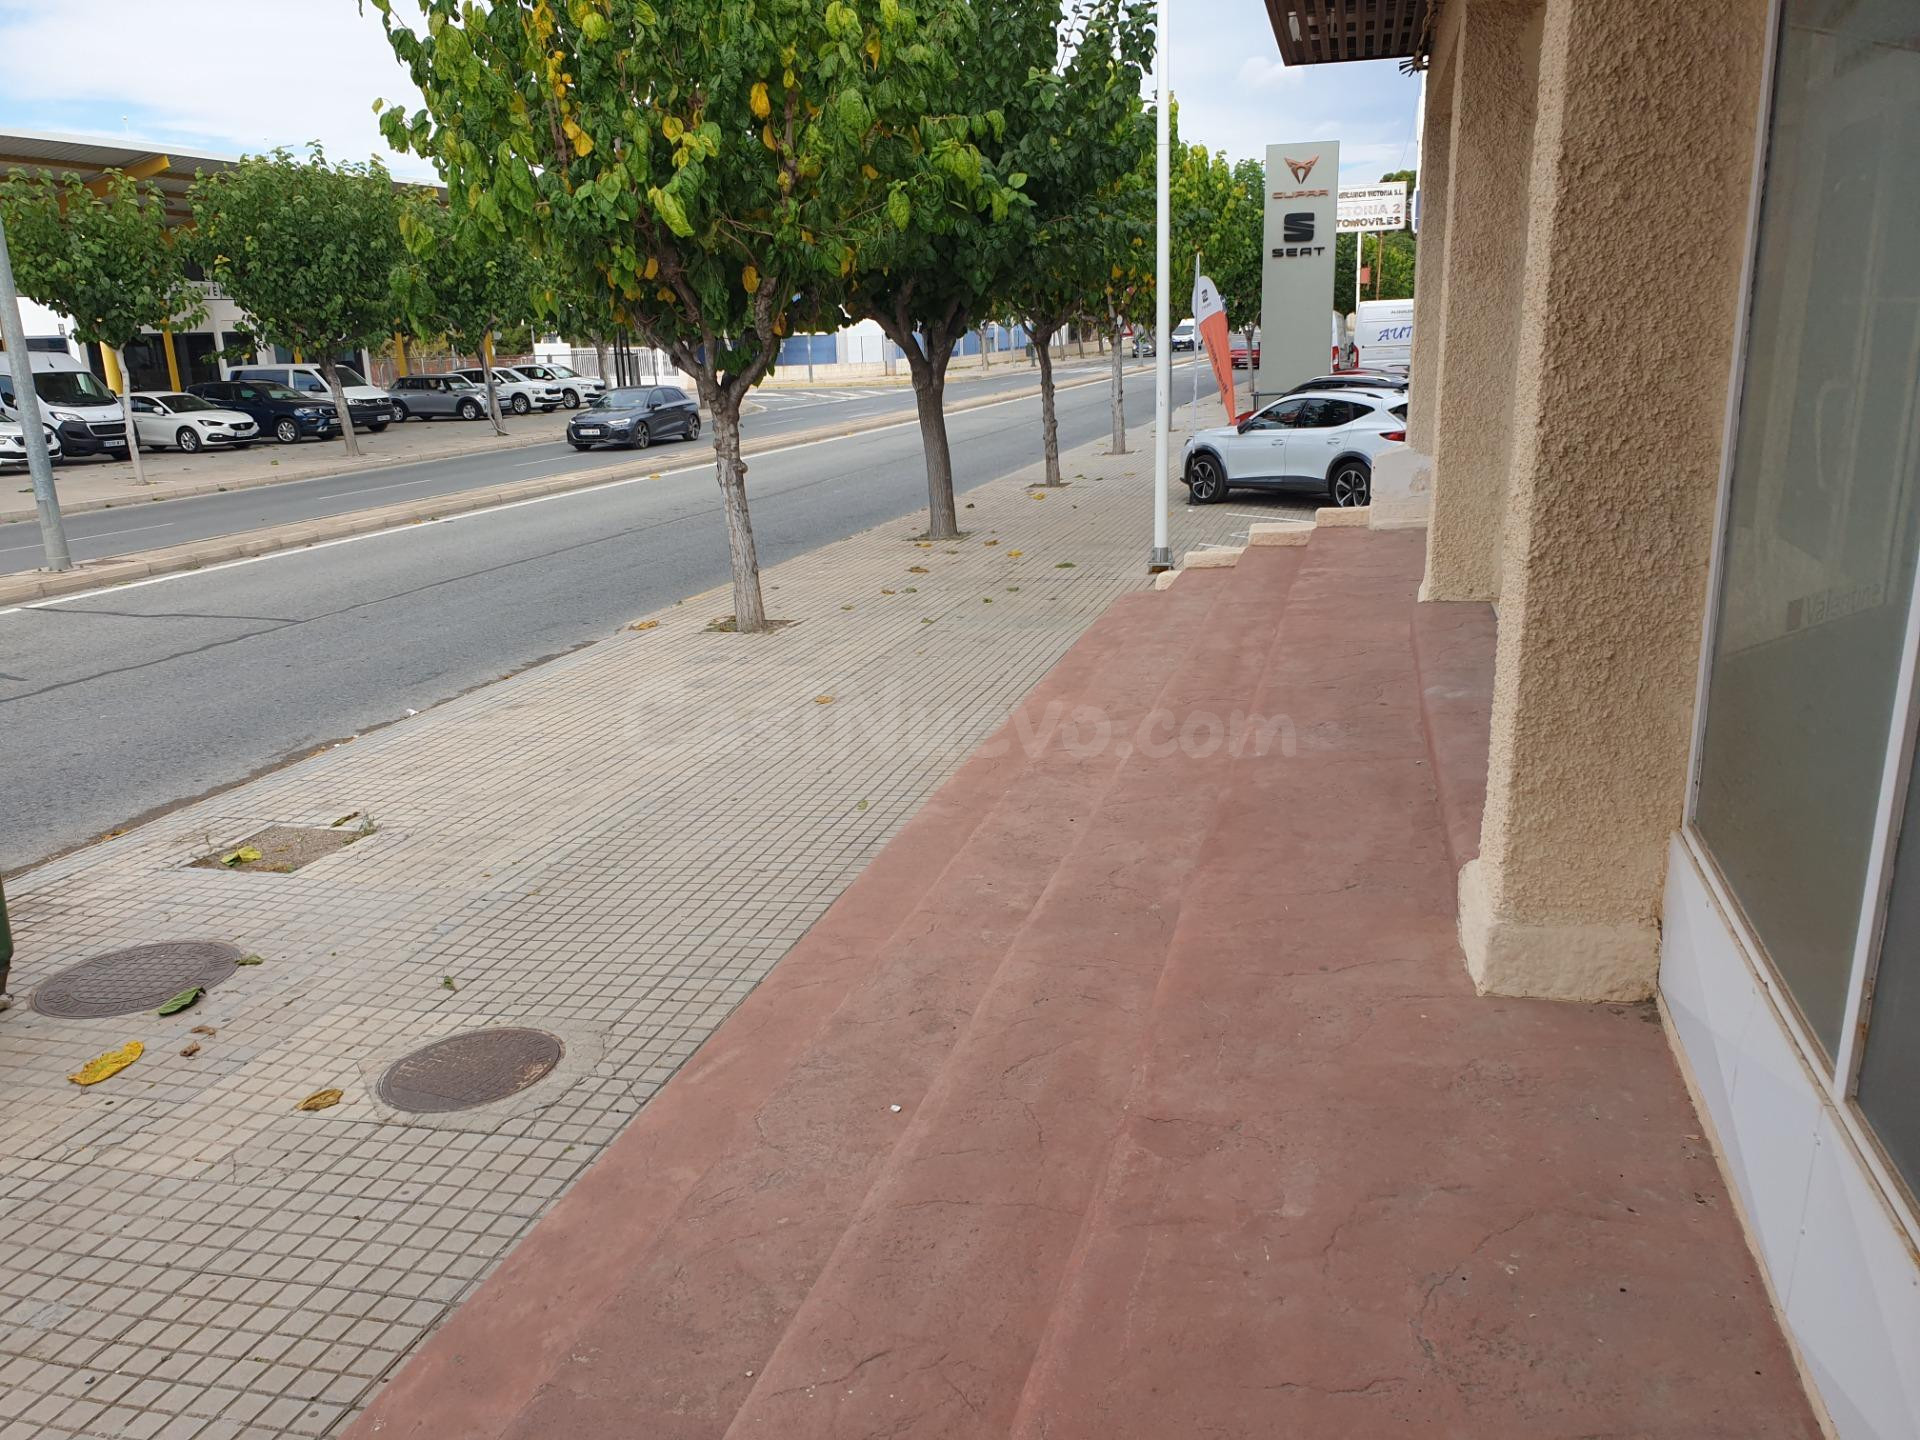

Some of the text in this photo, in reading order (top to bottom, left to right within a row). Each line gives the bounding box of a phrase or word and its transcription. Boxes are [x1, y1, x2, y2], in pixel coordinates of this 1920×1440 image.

[1272, 190, 1329, 199] CUPRA
[1392, 203, 1401, 213] 2
[1272, 248, 1325, 257] SEAT
